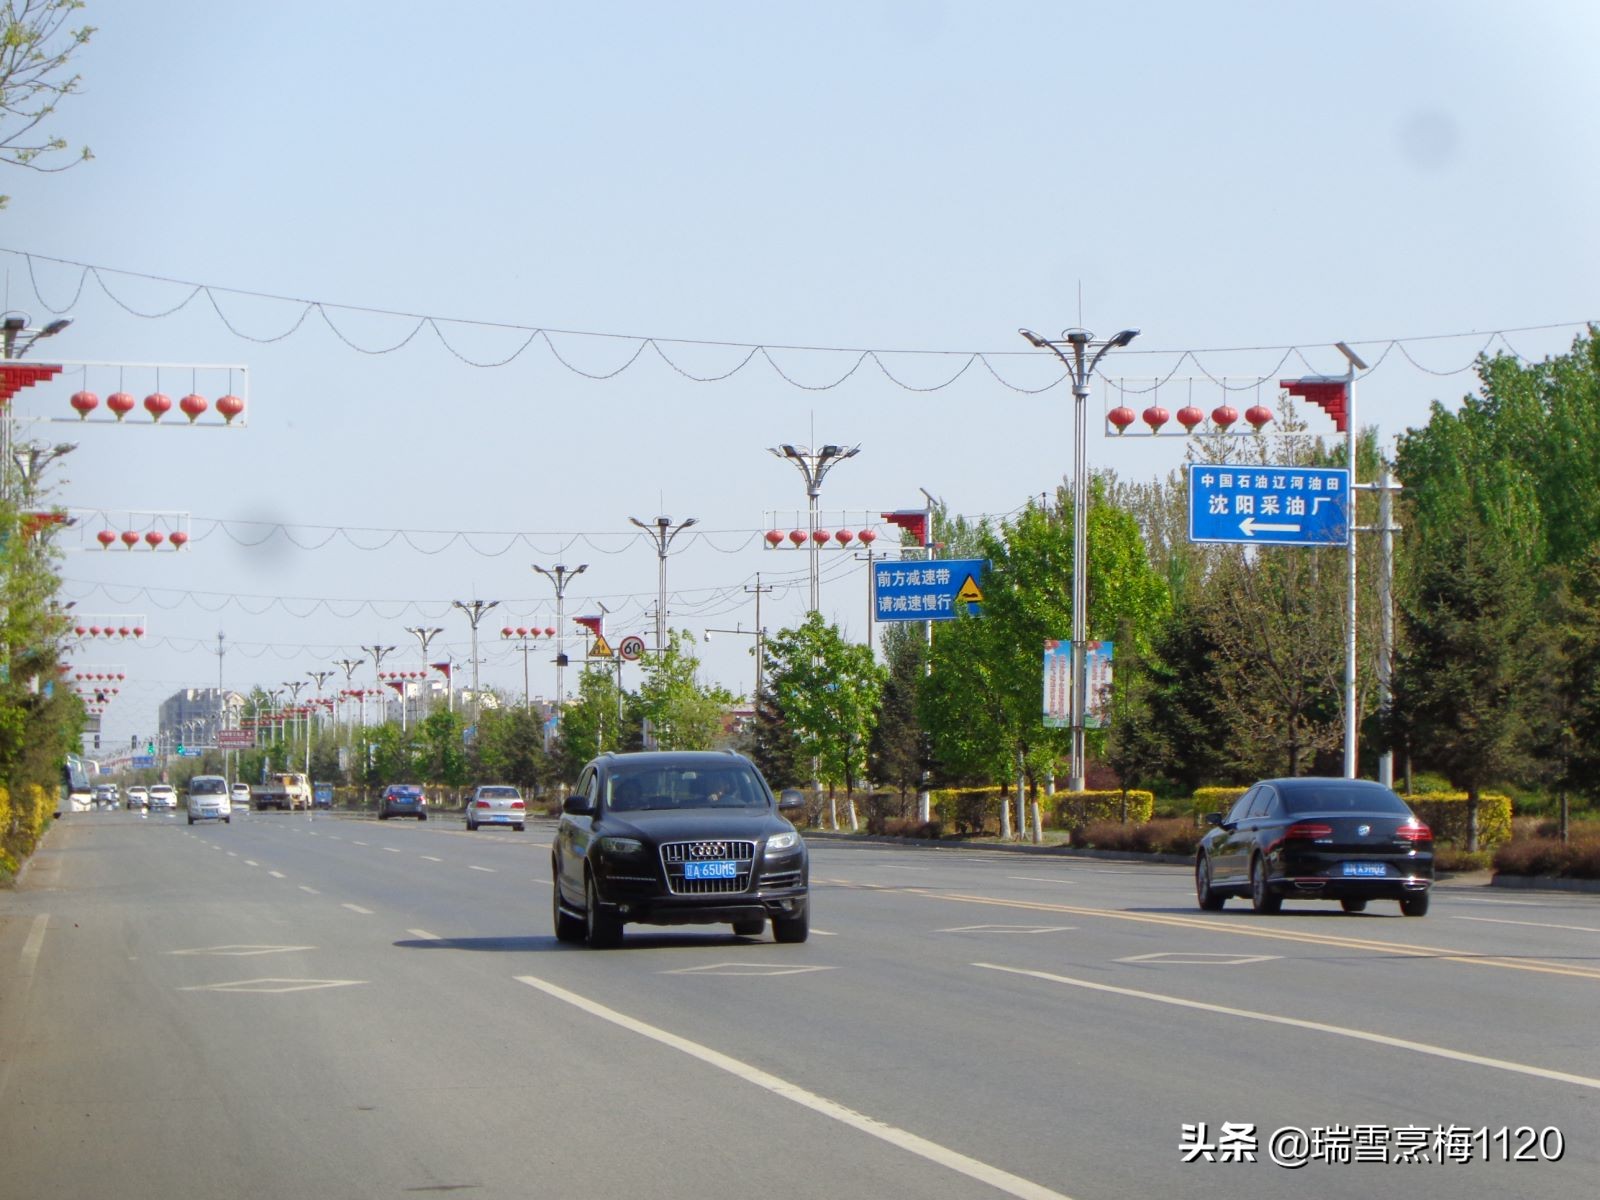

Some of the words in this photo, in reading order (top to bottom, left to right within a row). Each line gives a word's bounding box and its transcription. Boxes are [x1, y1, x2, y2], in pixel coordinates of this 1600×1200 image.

[1201, 473, 1340, 491] 中国石油辽河油田
[1208, 494, 1332, 516] 沈阳采油厂
[876, 568, 951, 588] 前方减速带
[878, 593, 952, 612] 请减速慢行
[624, 641, 641, 655] 60
